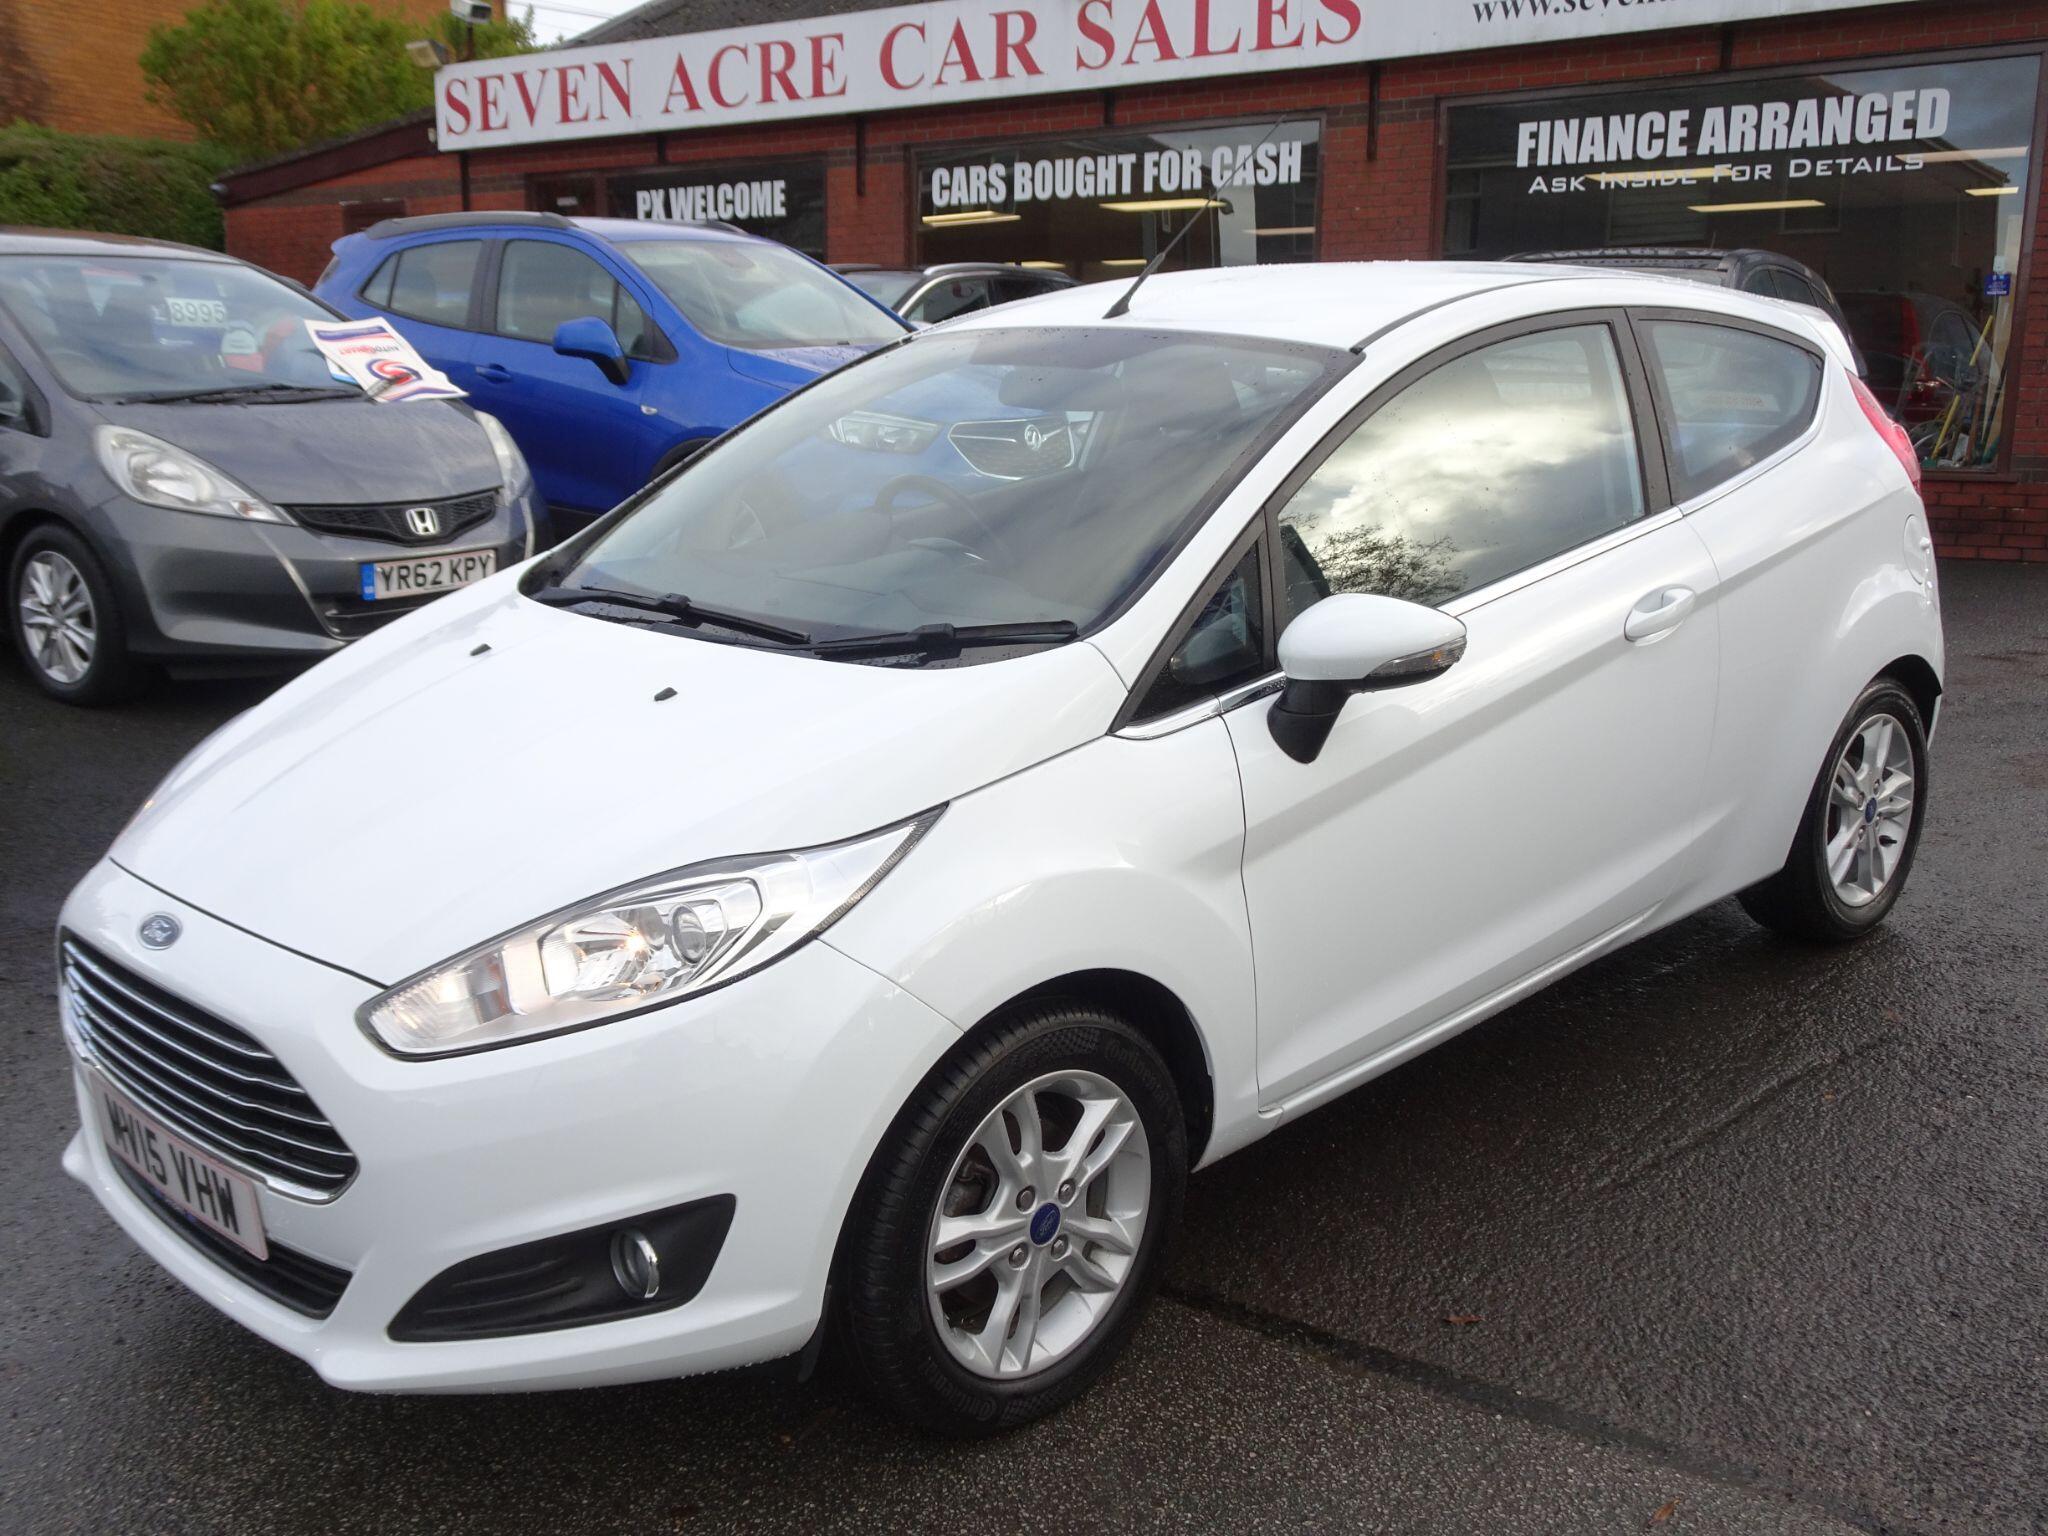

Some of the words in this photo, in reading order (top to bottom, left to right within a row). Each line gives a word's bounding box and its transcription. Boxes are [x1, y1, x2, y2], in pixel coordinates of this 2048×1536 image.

[444, 58, 633, 136] SEVEN
[661, 32, 848, 116] ACRE
[879, 9, 1045, 91] CAR
[1076, 0, 1362, 72] SALES
[1516, 108, 1690, 168] FINANCE
[1696, 87, 1951, 156] ARRANGED
[636, 189, 667, 221] PX
[669, 179, 787, 221] WELCOME
[931, 161, 1007, 208] CARS
[1013, 153, 1137, 201] BOUGHT
[1143, 150, 1203, 193] FOR
[1211, 140, 1302, 189] CASH
[1528, 174, 1586, 195] ASK
[1600, 168, 1697, 191] INSIDE
[1713, 163, 1772, 184] FOR
[1789, 154, 1925, 178] DETAILS
[380, 561, 443, 592] YR62
[449, 554, 490, 584] KPY
[168, 1142, 240, 1235] VHW
